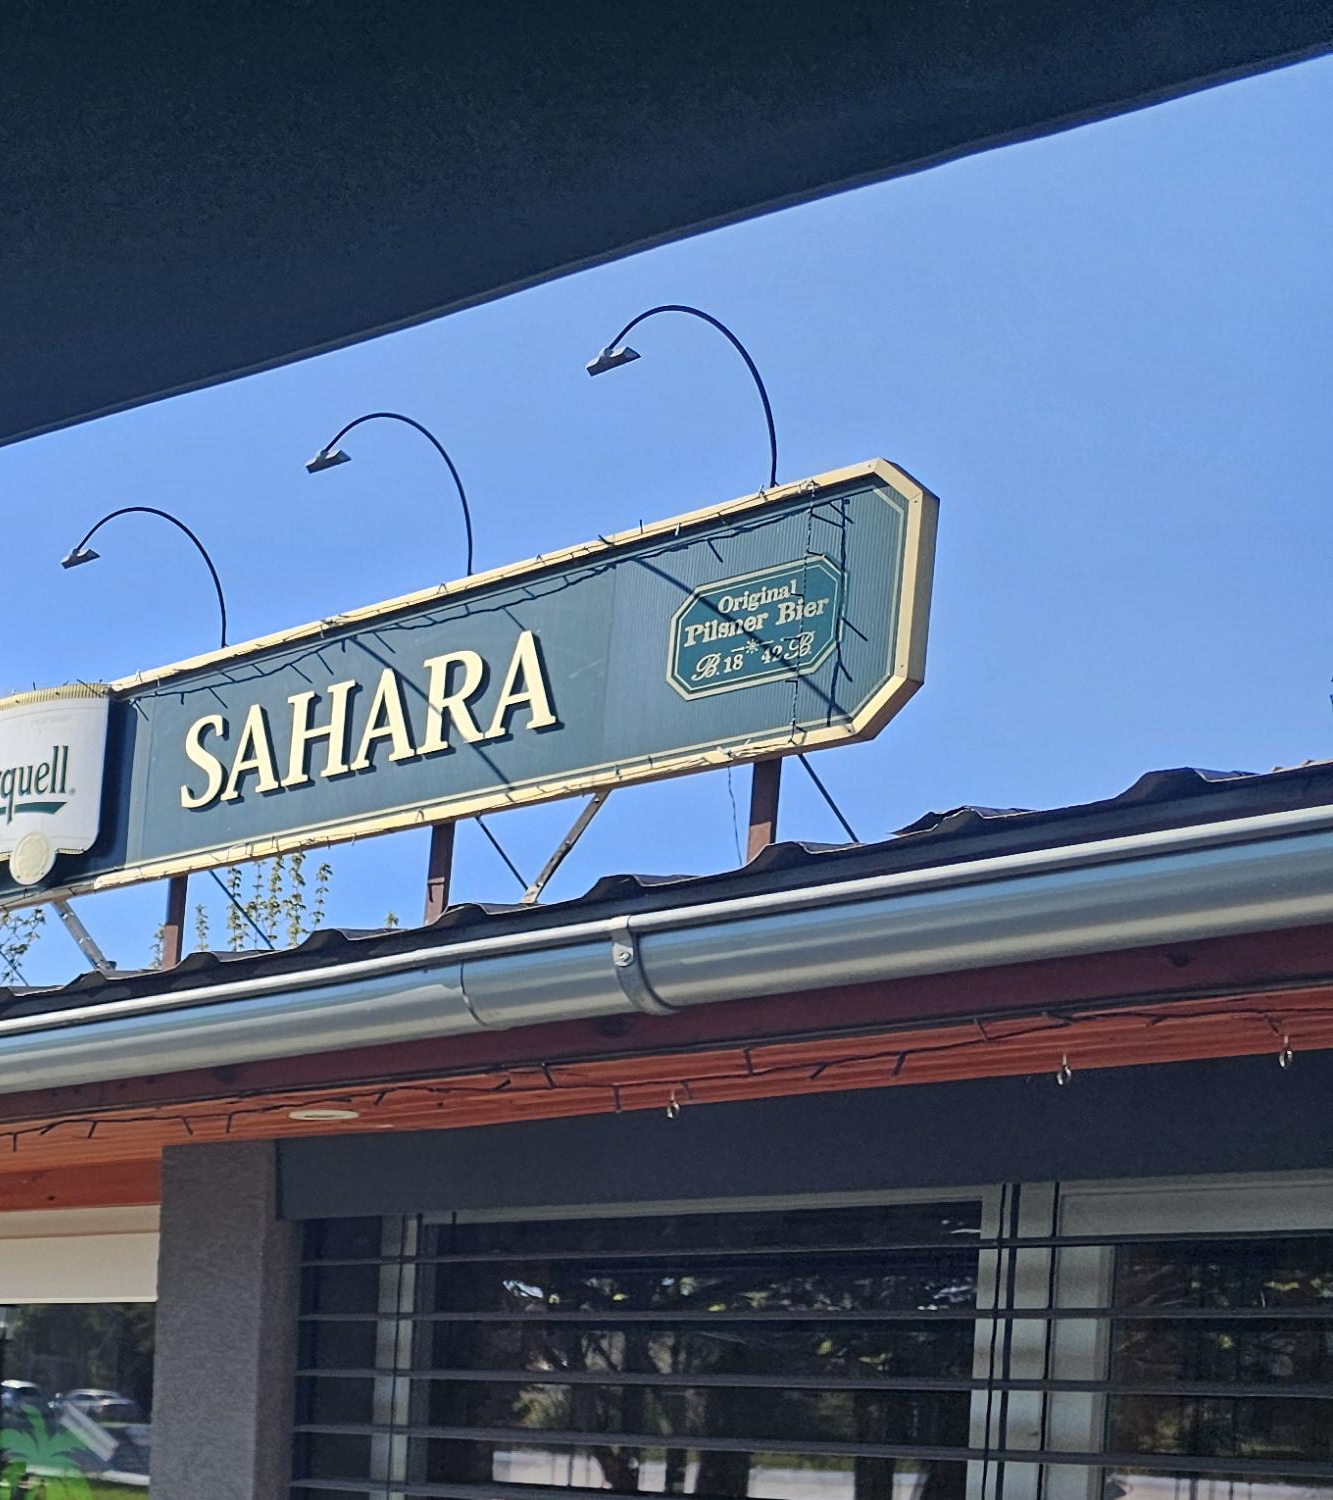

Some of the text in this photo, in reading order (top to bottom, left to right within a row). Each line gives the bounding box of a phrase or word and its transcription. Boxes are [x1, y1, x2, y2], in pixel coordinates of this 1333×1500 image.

[717, 579, 797, 614] Original
[683, 597, 830, 648] Pilsner Bier
[723, 653, 744, 674] 18
[179, 629, 557, 810] SAHARA
